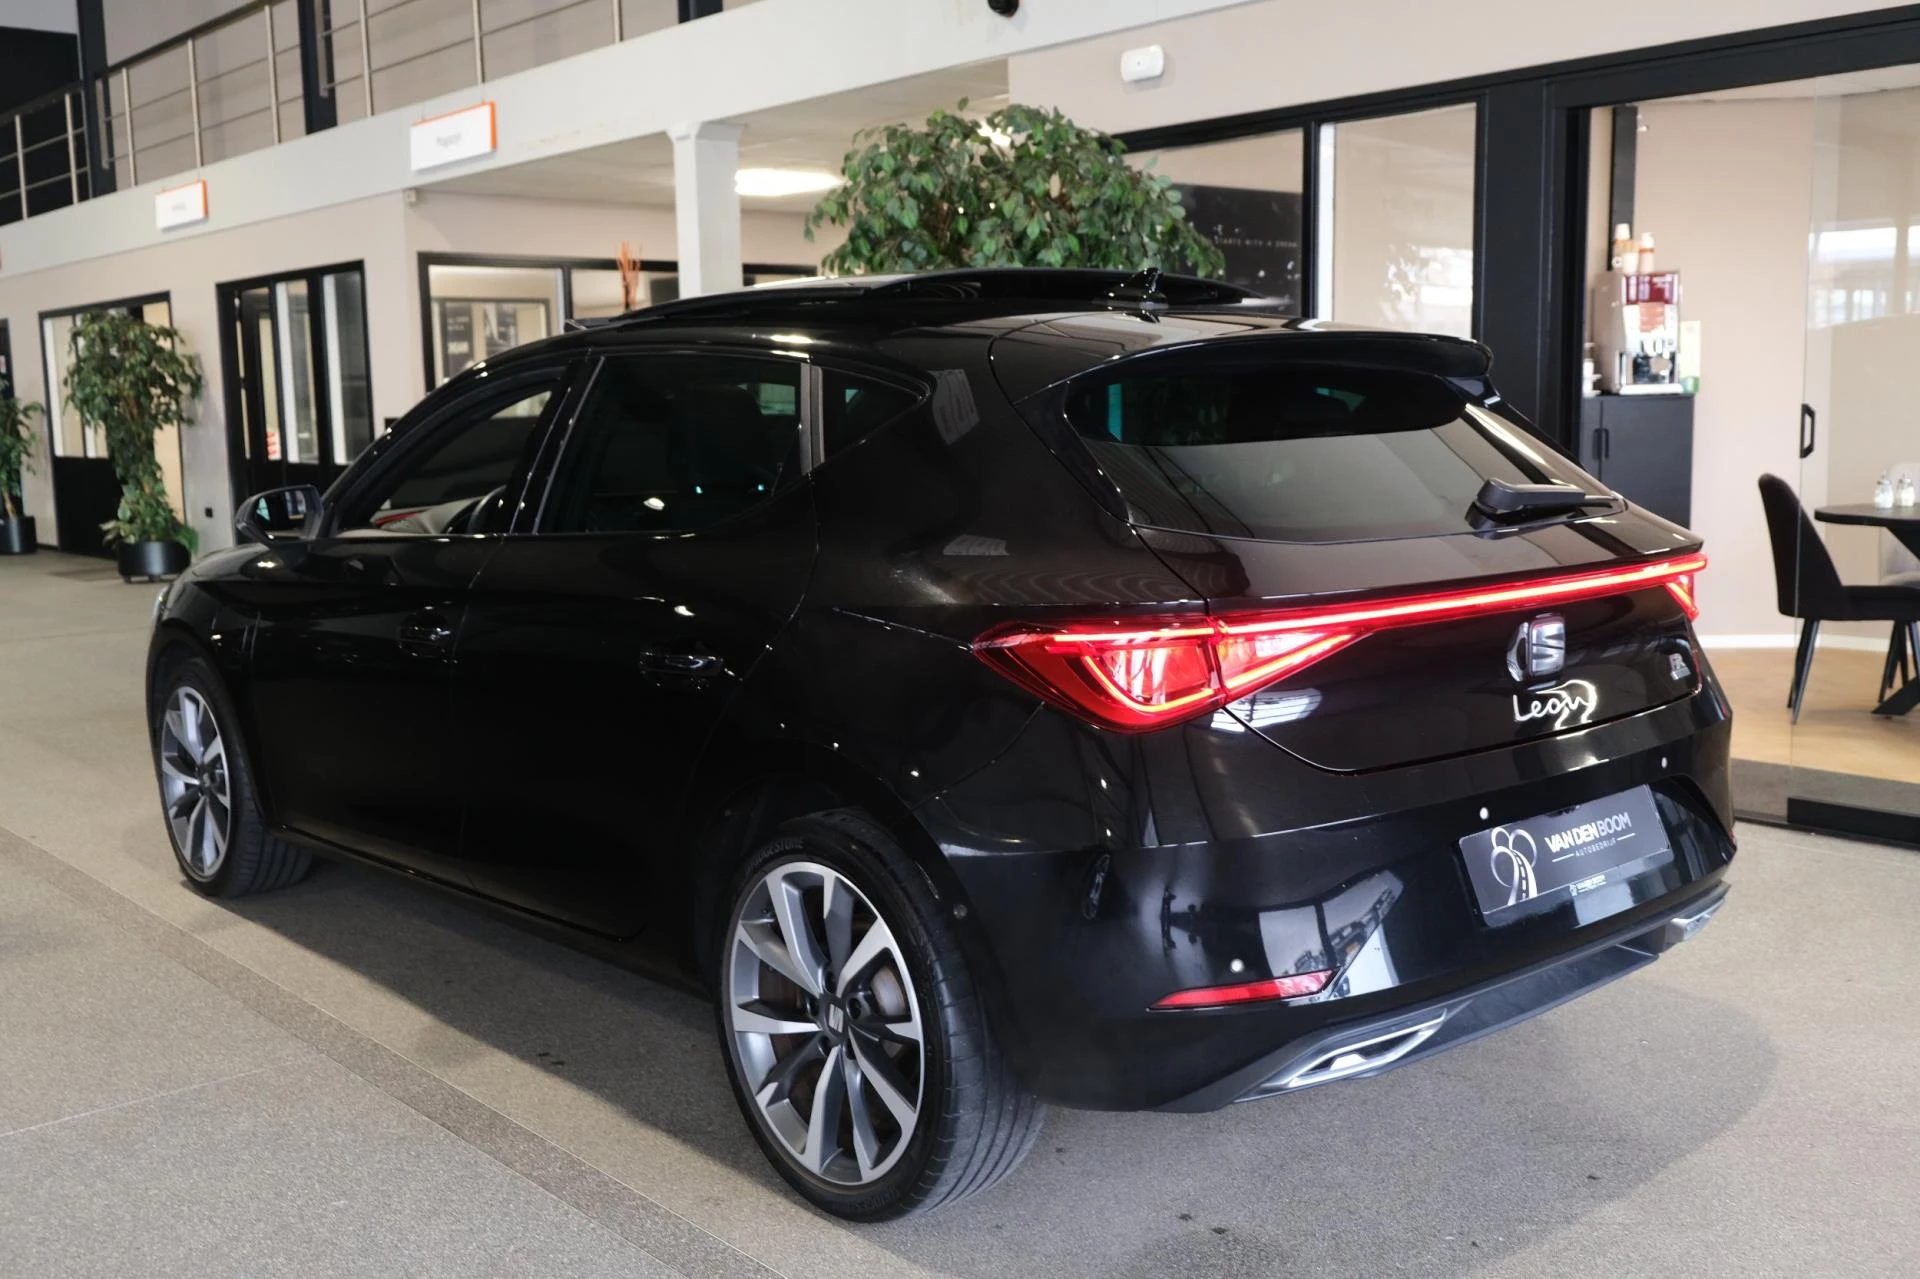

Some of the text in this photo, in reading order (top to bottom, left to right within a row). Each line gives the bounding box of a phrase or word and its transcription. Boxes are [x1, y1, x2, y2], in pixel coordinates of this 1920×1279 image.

[1512, 692, 1588, 722] Leon
[1544, 812, 1631, 852] VAN DEN BOOM
[1575, 838, 1616, 857] AUTOBEDRIJF
